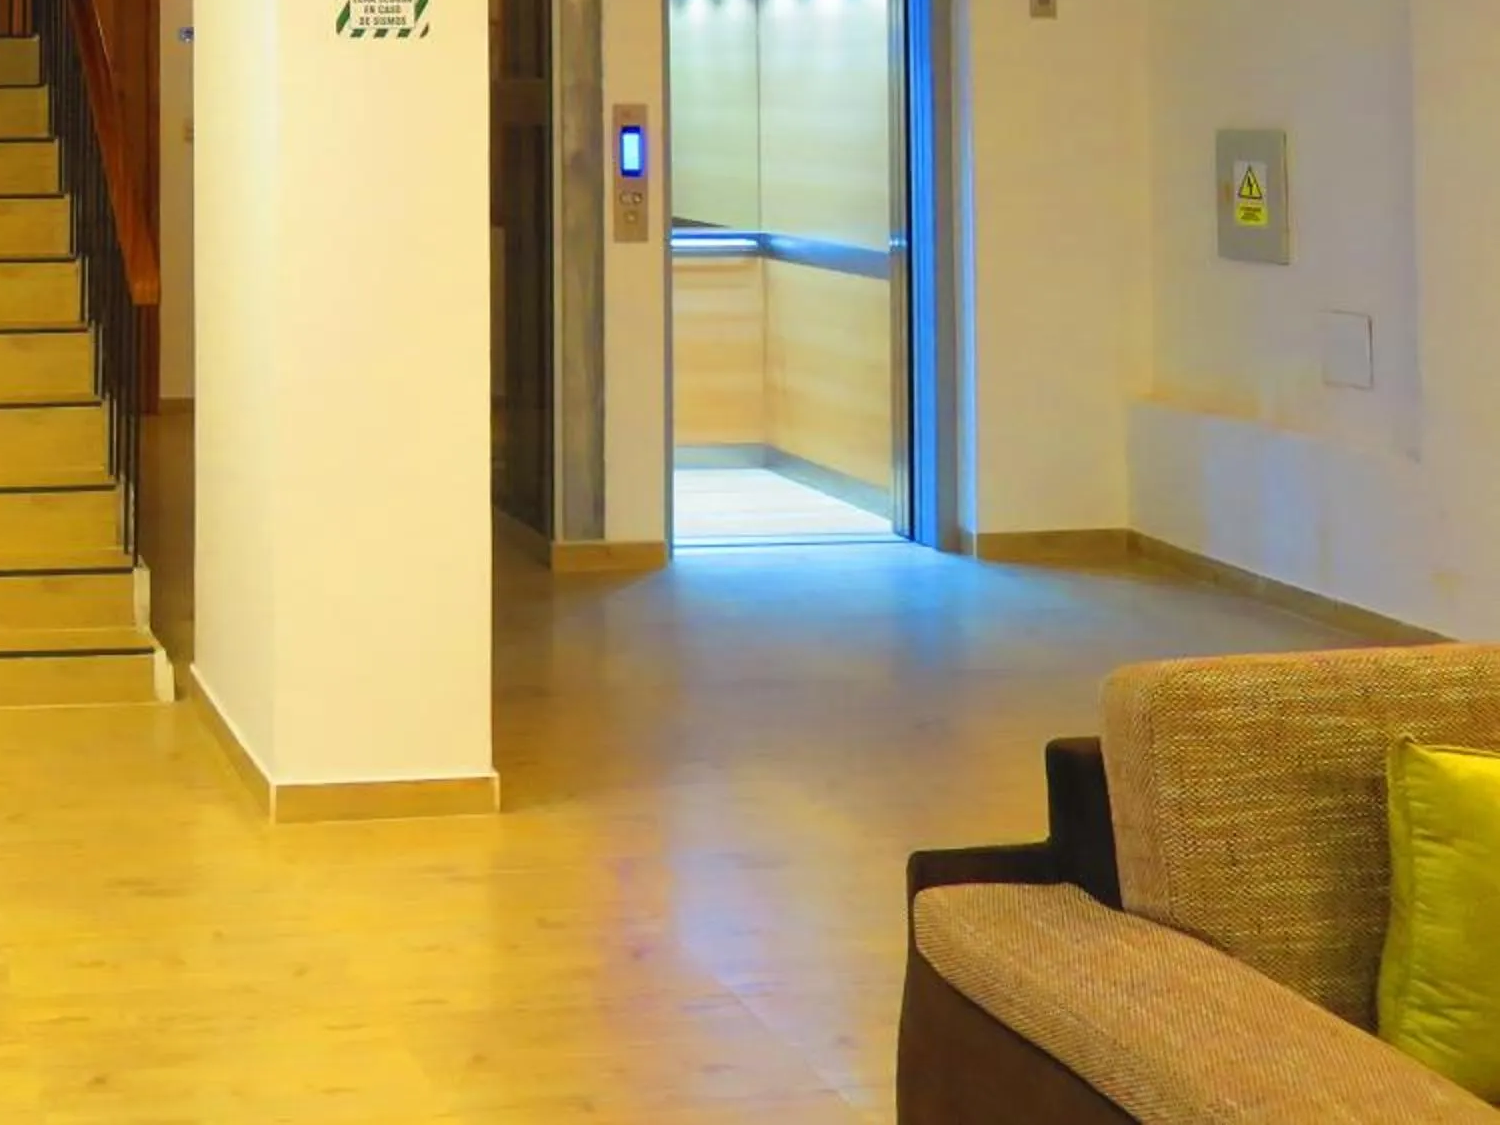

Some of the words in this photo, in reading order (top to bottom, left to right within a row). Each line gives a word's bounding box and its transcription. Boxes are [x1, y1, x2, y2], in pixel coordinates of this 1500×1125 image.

[364, 5, 375, 13] EN
[378, 5, 401, 13] CASO
[359, 17, 370, 25] DE
[373, 17, 406, 25] SISMOS
